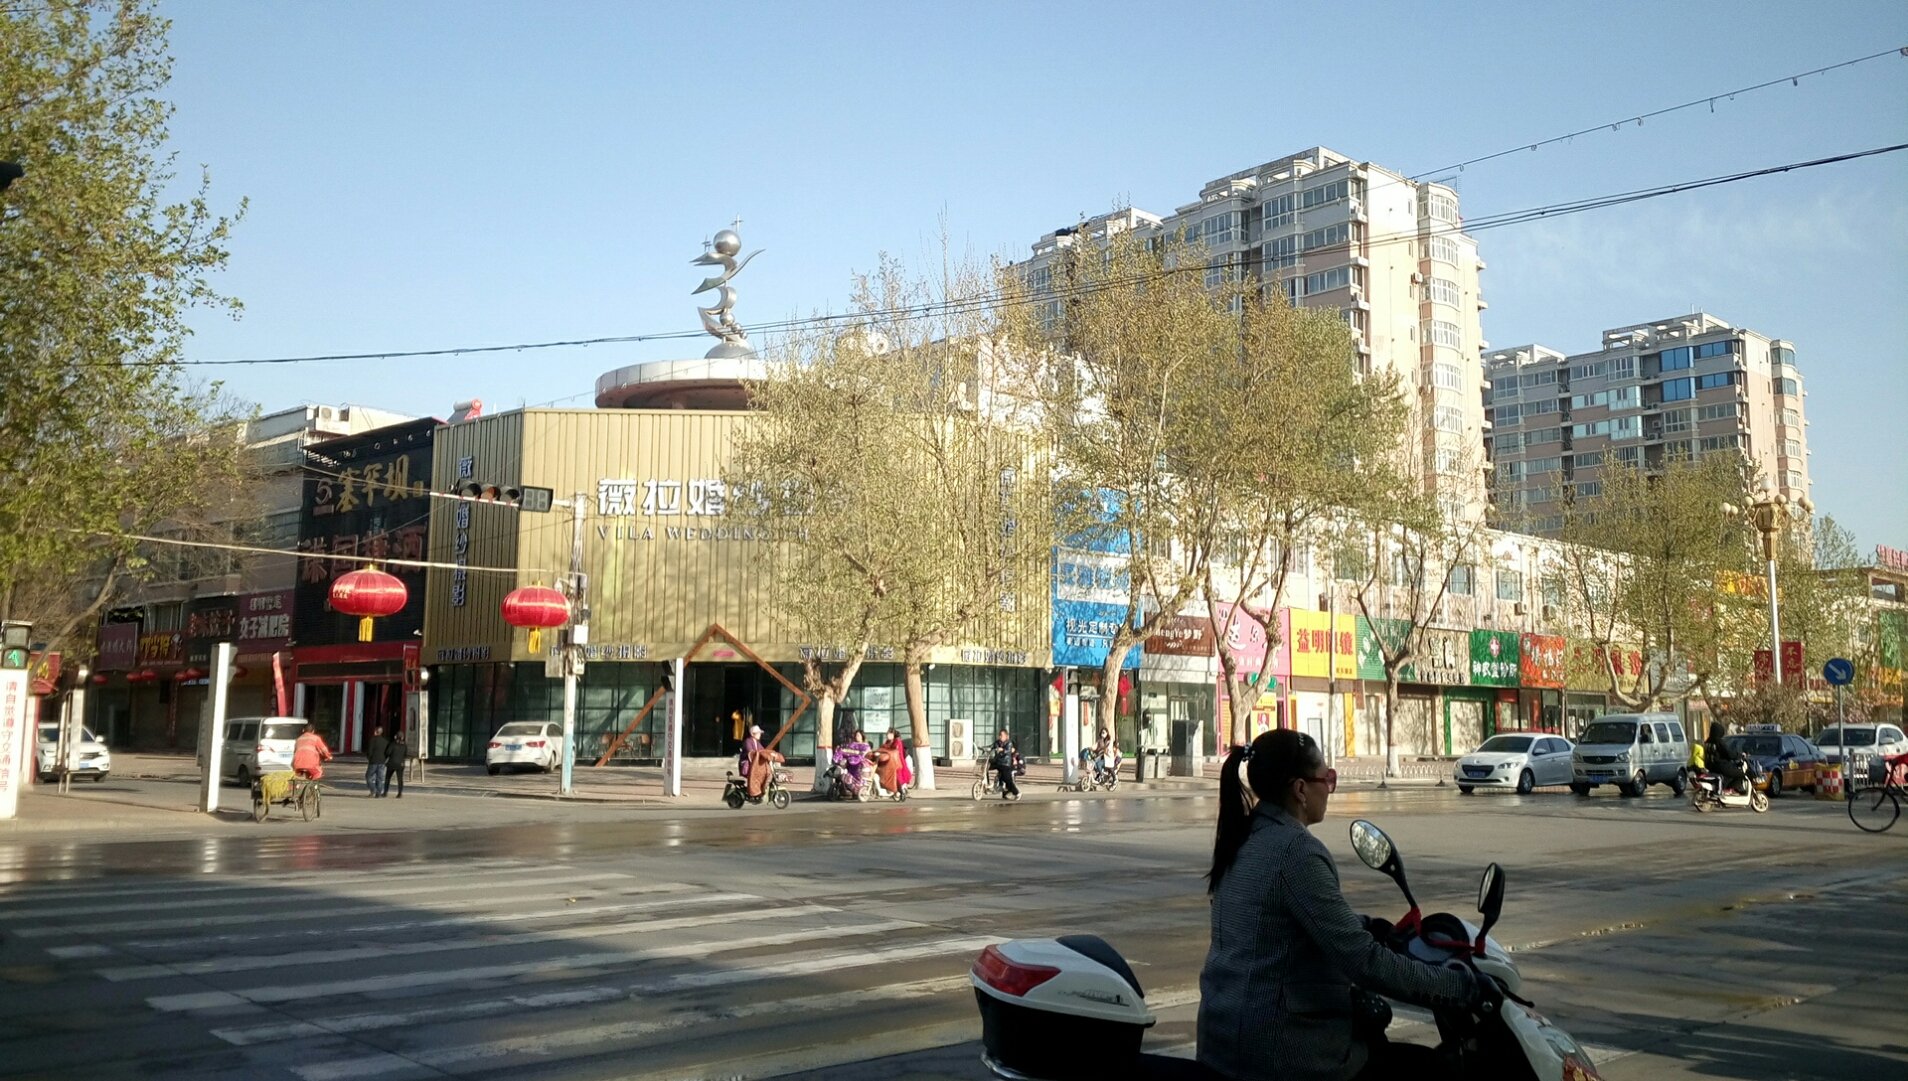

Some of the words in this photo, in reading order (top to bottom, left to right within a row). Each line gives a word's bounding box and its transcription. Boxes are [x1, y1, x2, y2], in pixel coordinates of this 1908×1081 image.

[452, 456, 474, 607] 薇婚纱摄影
[597, 526, 655, 541] VILA
